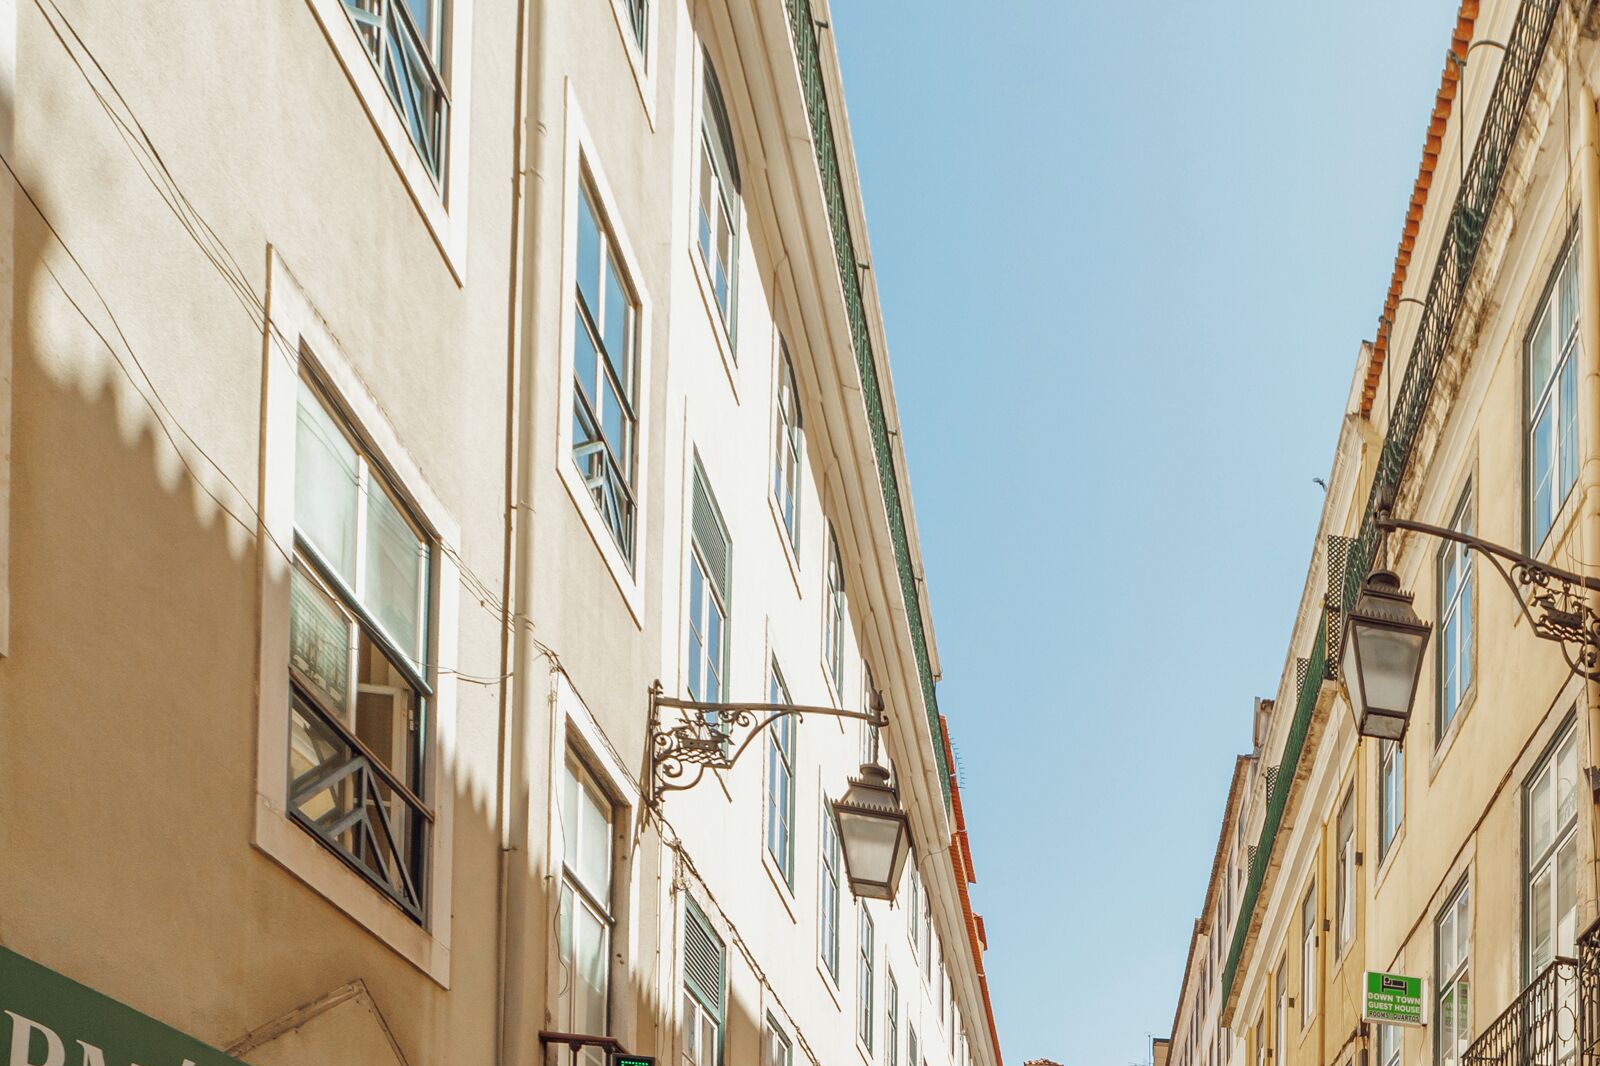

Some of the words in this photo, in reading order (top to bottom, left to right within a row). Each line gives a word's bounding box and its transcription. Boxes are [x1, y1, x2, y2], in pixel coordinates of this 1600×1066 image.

[1368, 992, 1393, 1002] DOWN
[1395, 995, 1421, 1005] TOWN
[1368, 1001, 1393, 1011] GUEST
[1395, 1004, 1421, 1014] HOUSE
